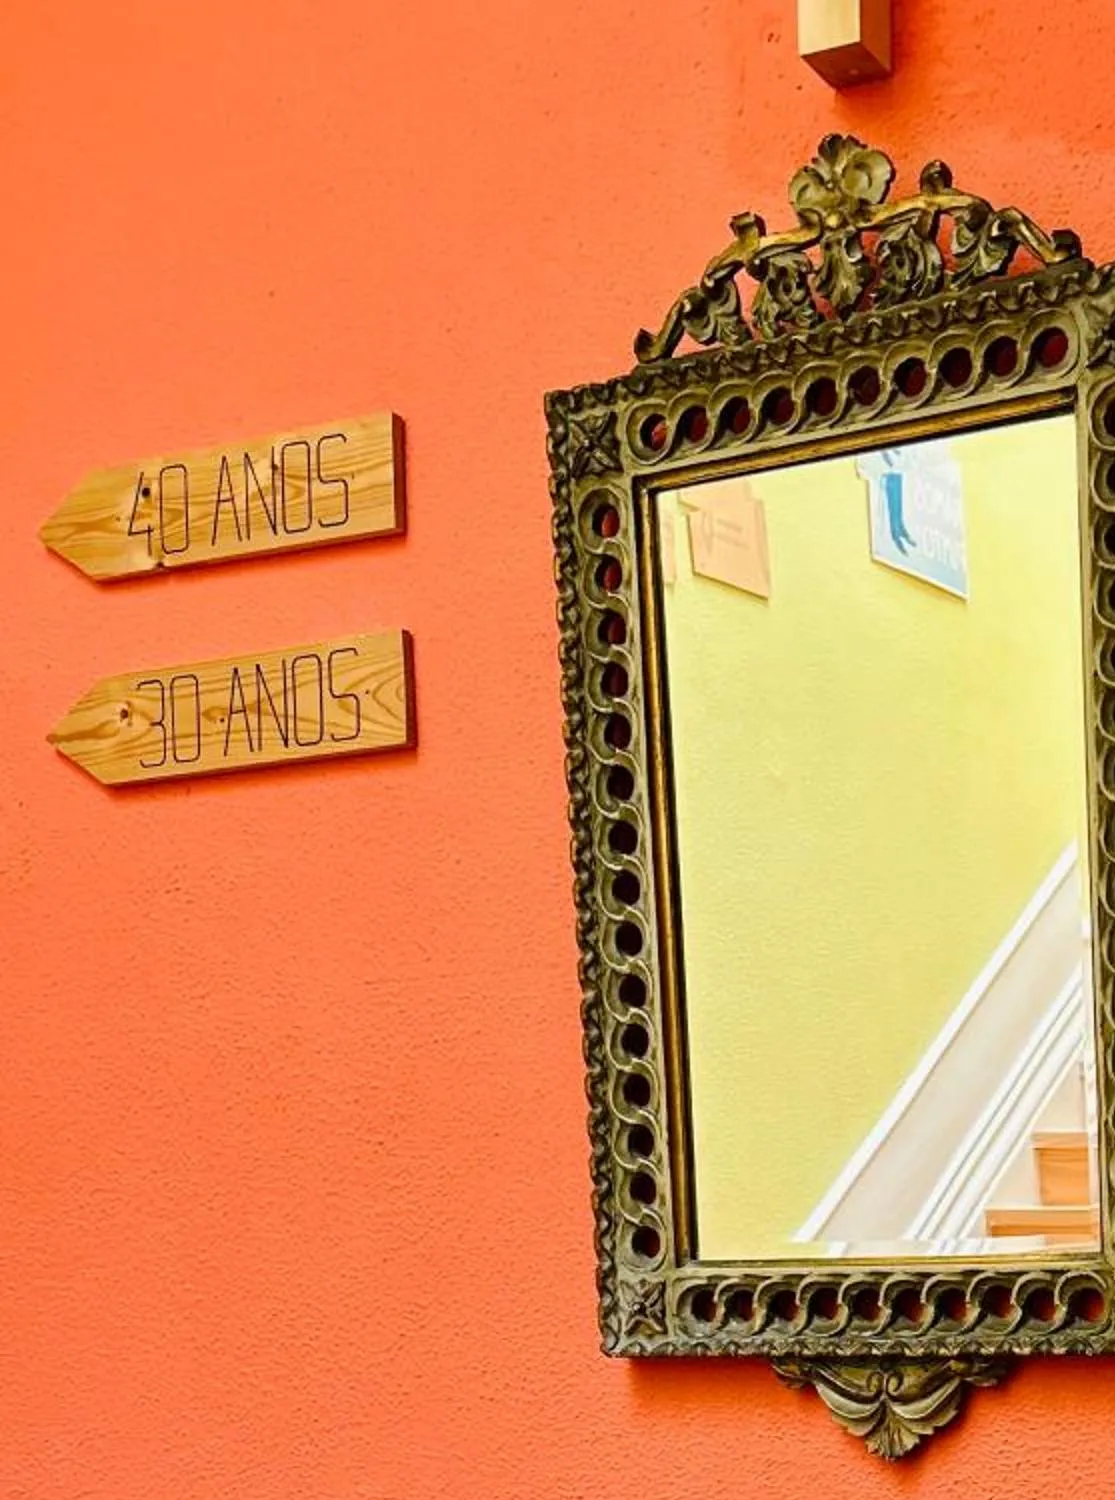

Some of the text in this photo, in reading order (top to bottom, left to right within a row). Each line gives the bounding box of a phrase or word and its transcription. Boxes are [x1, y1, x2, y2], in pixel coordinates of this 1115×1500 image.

[127, 432, 350, 557] 40 ANOS
[135, 647, 361, 769] 30 ANOS
